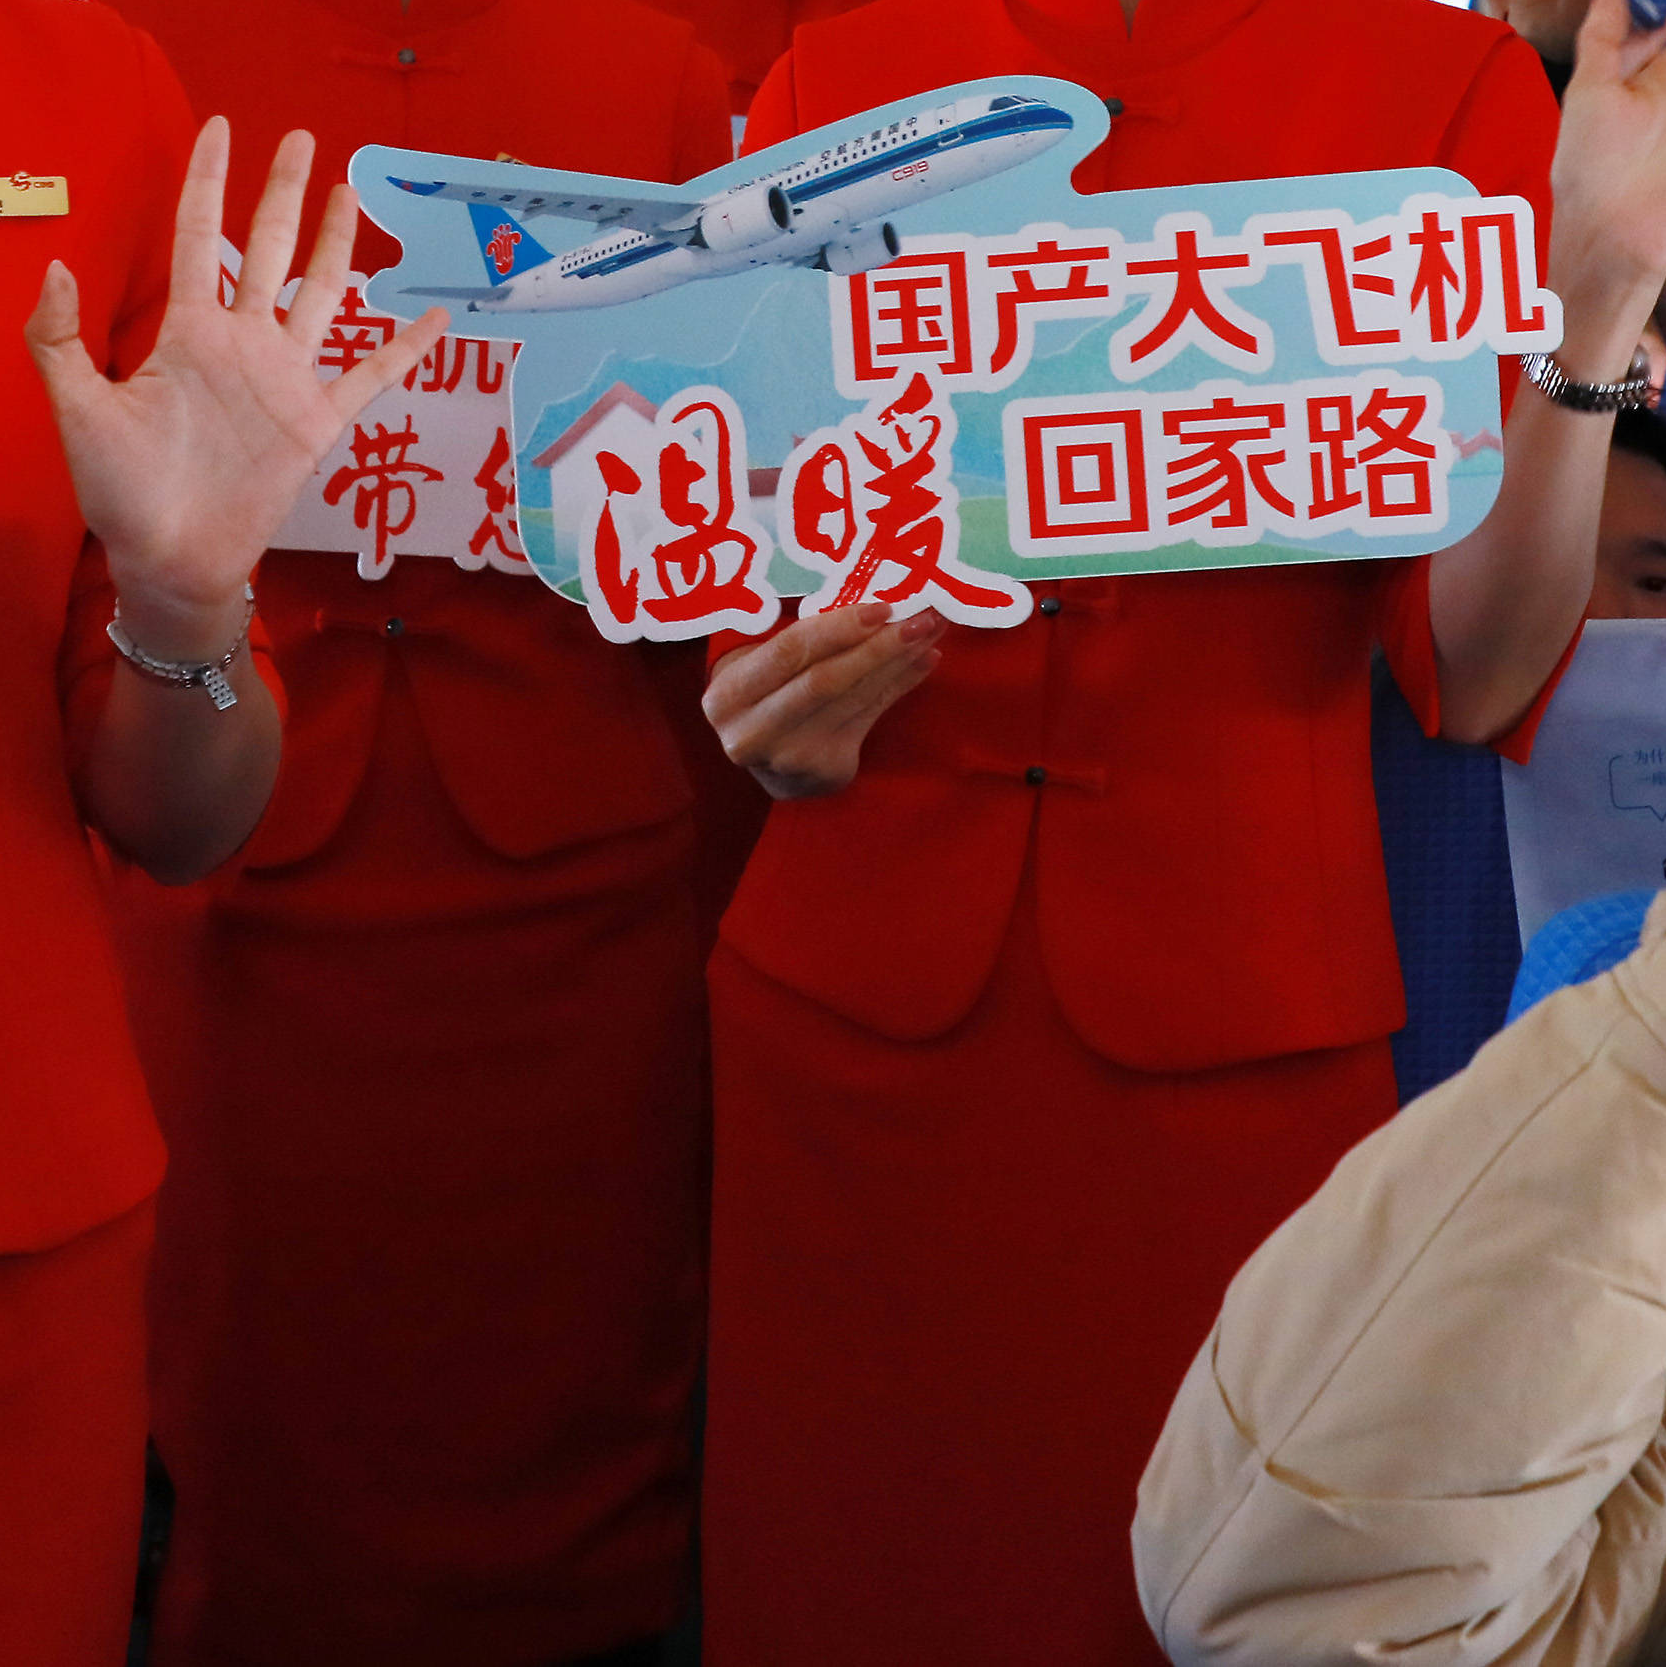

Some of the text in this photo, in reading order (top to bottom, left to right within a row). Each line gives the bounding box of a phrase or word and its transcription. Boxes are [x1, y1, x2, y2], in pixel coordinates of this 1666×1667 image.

[891, 159, 930, 182] C919
[847, 208, 1546, 382] 国产大飞机
[594, 370, 1015, 624] 温暖
[1021, 387, 1437, 541] 回家路
